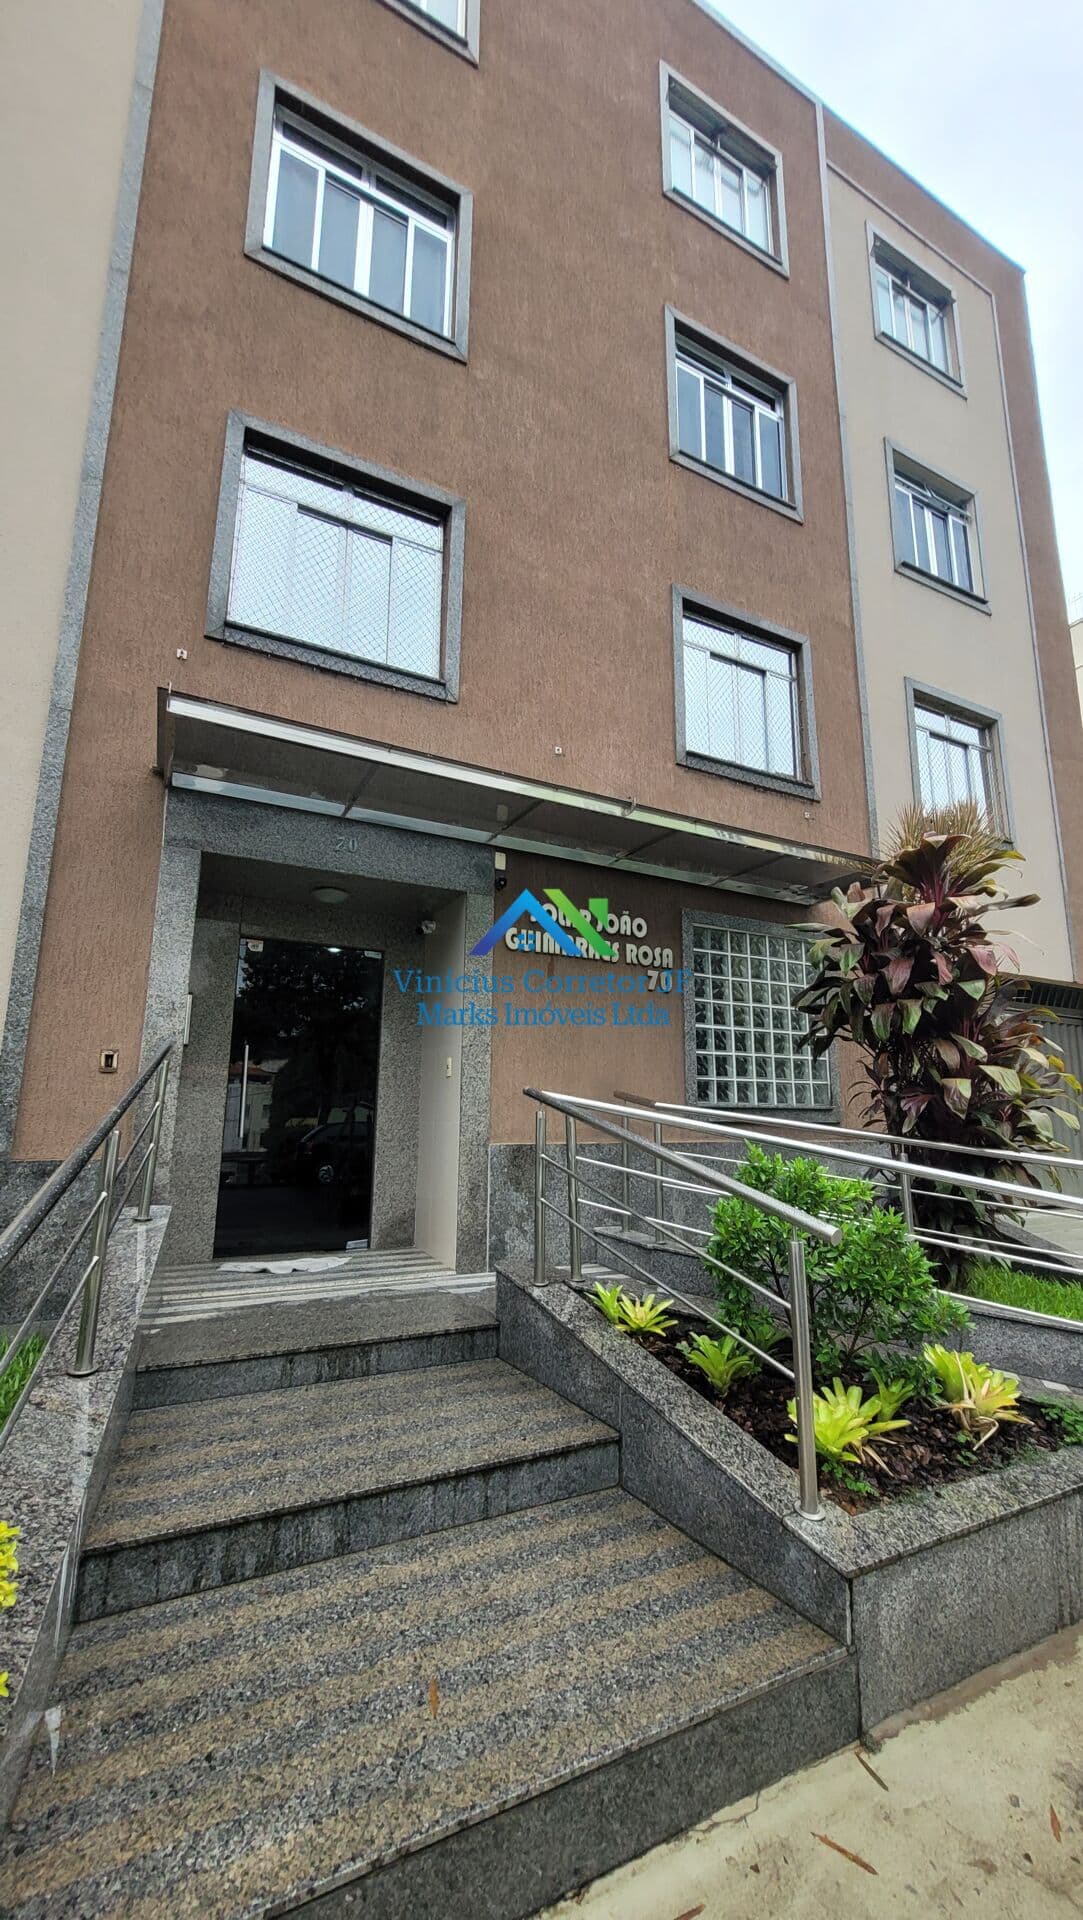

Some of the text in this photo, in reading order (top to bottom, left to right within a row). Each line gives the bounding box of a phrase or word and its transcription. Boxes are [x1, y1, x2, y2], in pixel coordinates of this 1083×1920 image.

[530, 903, 592, 930] OLR
[625, 943, 673, 969] ROSA
[647, 970, 673, 993] 70
